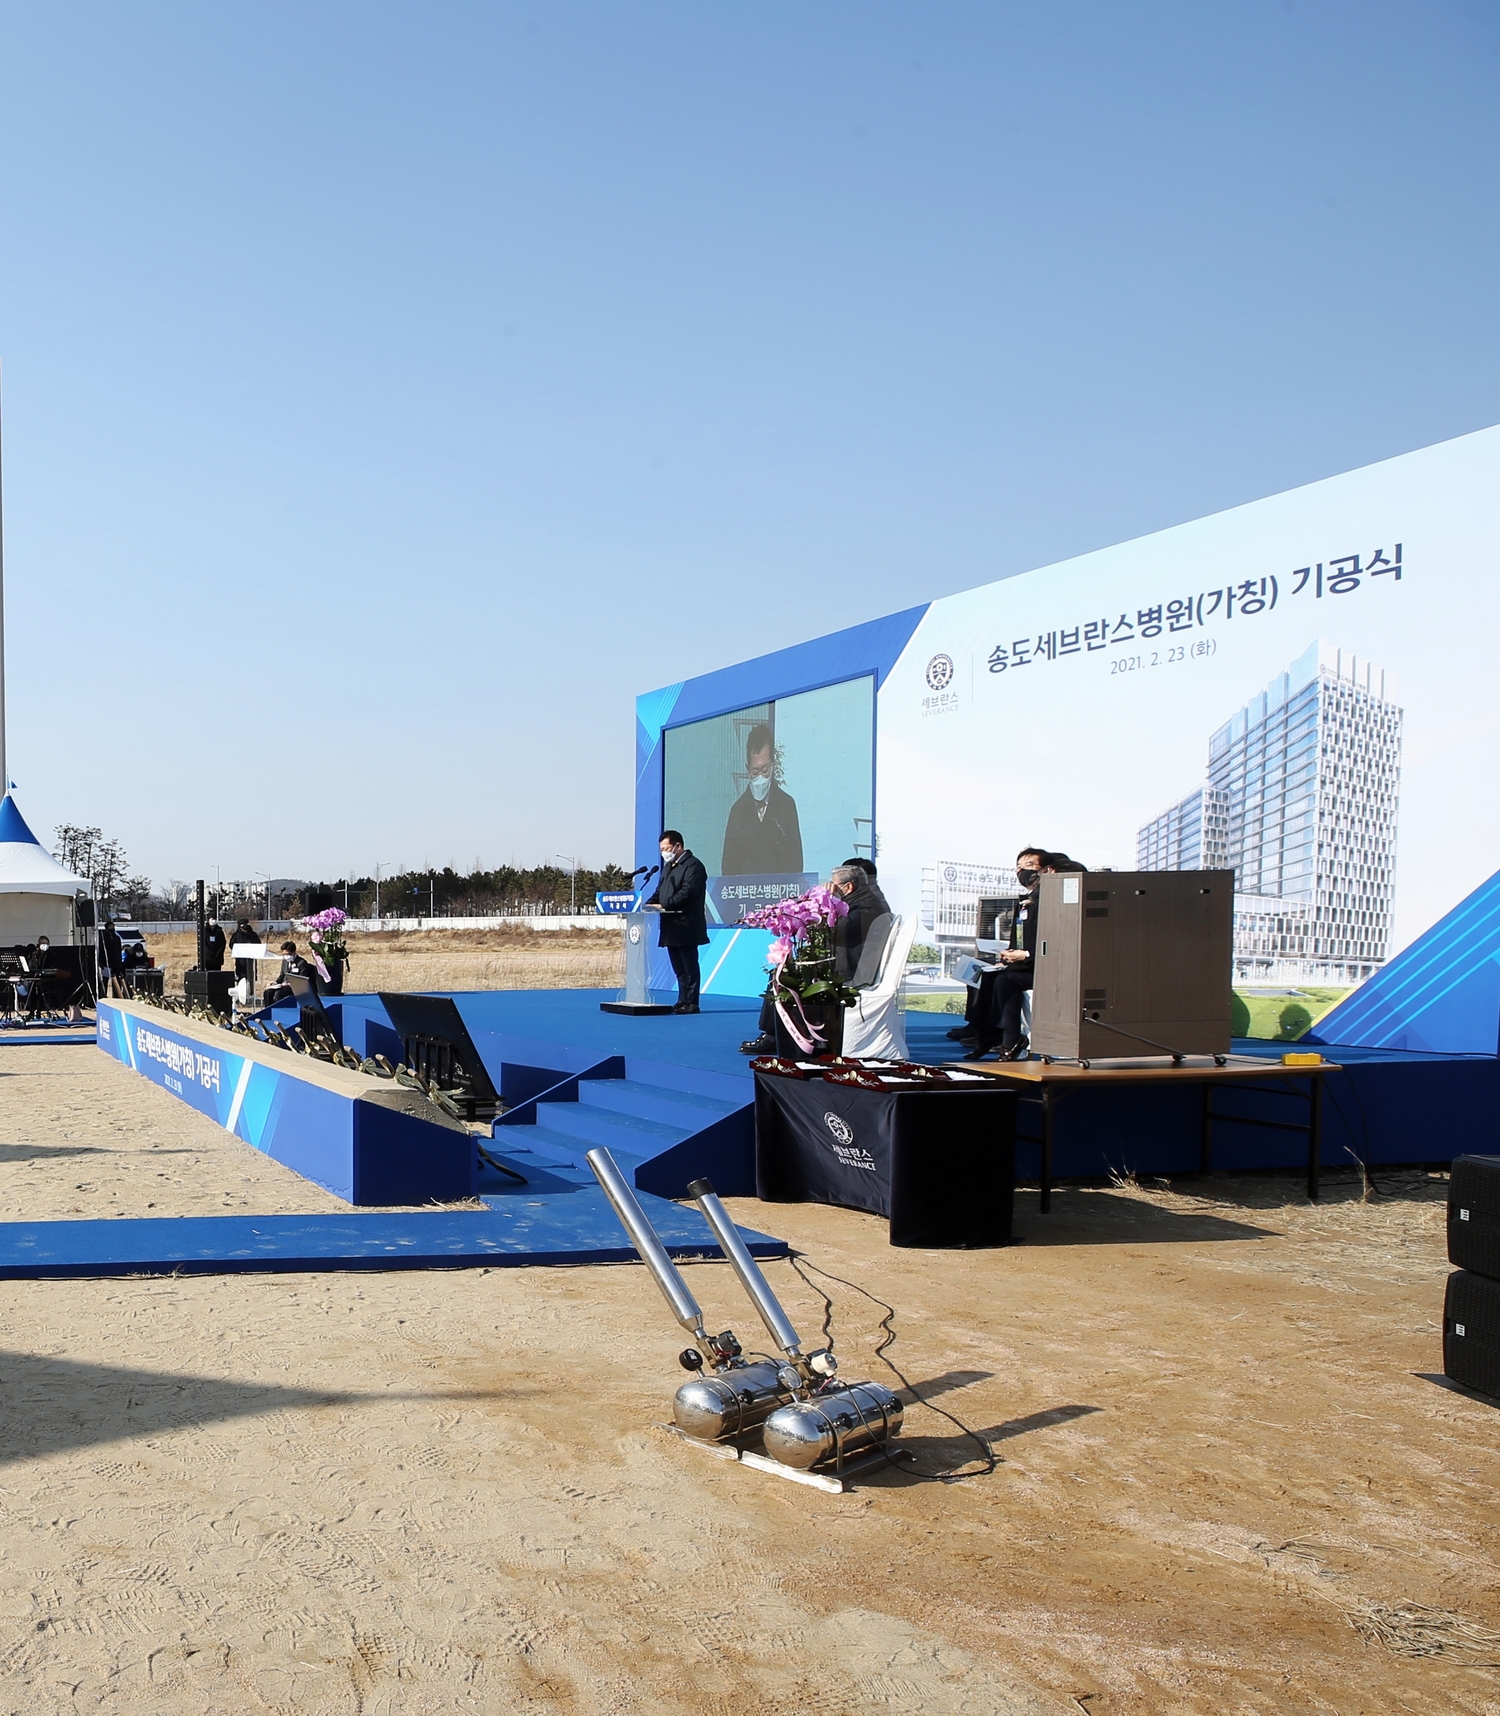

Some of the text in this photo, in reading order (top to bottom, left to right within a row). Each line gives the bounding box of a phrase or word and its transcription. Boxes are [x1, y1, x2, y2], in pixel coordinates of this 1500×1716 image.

[987, 542, 1403, 674] 송도세브란스병원(가칭) 기공식
[1110, 638, 1218, 675] 2021. 2. 23 (화)
[921, 692, 959, 709] 세브란스
[921, 704, 959, 718] SEVERANCE
[721, 883, 800, 899] 송도세브란스병원(가칭)
[195, 1053, 220, 1093] 기공식
